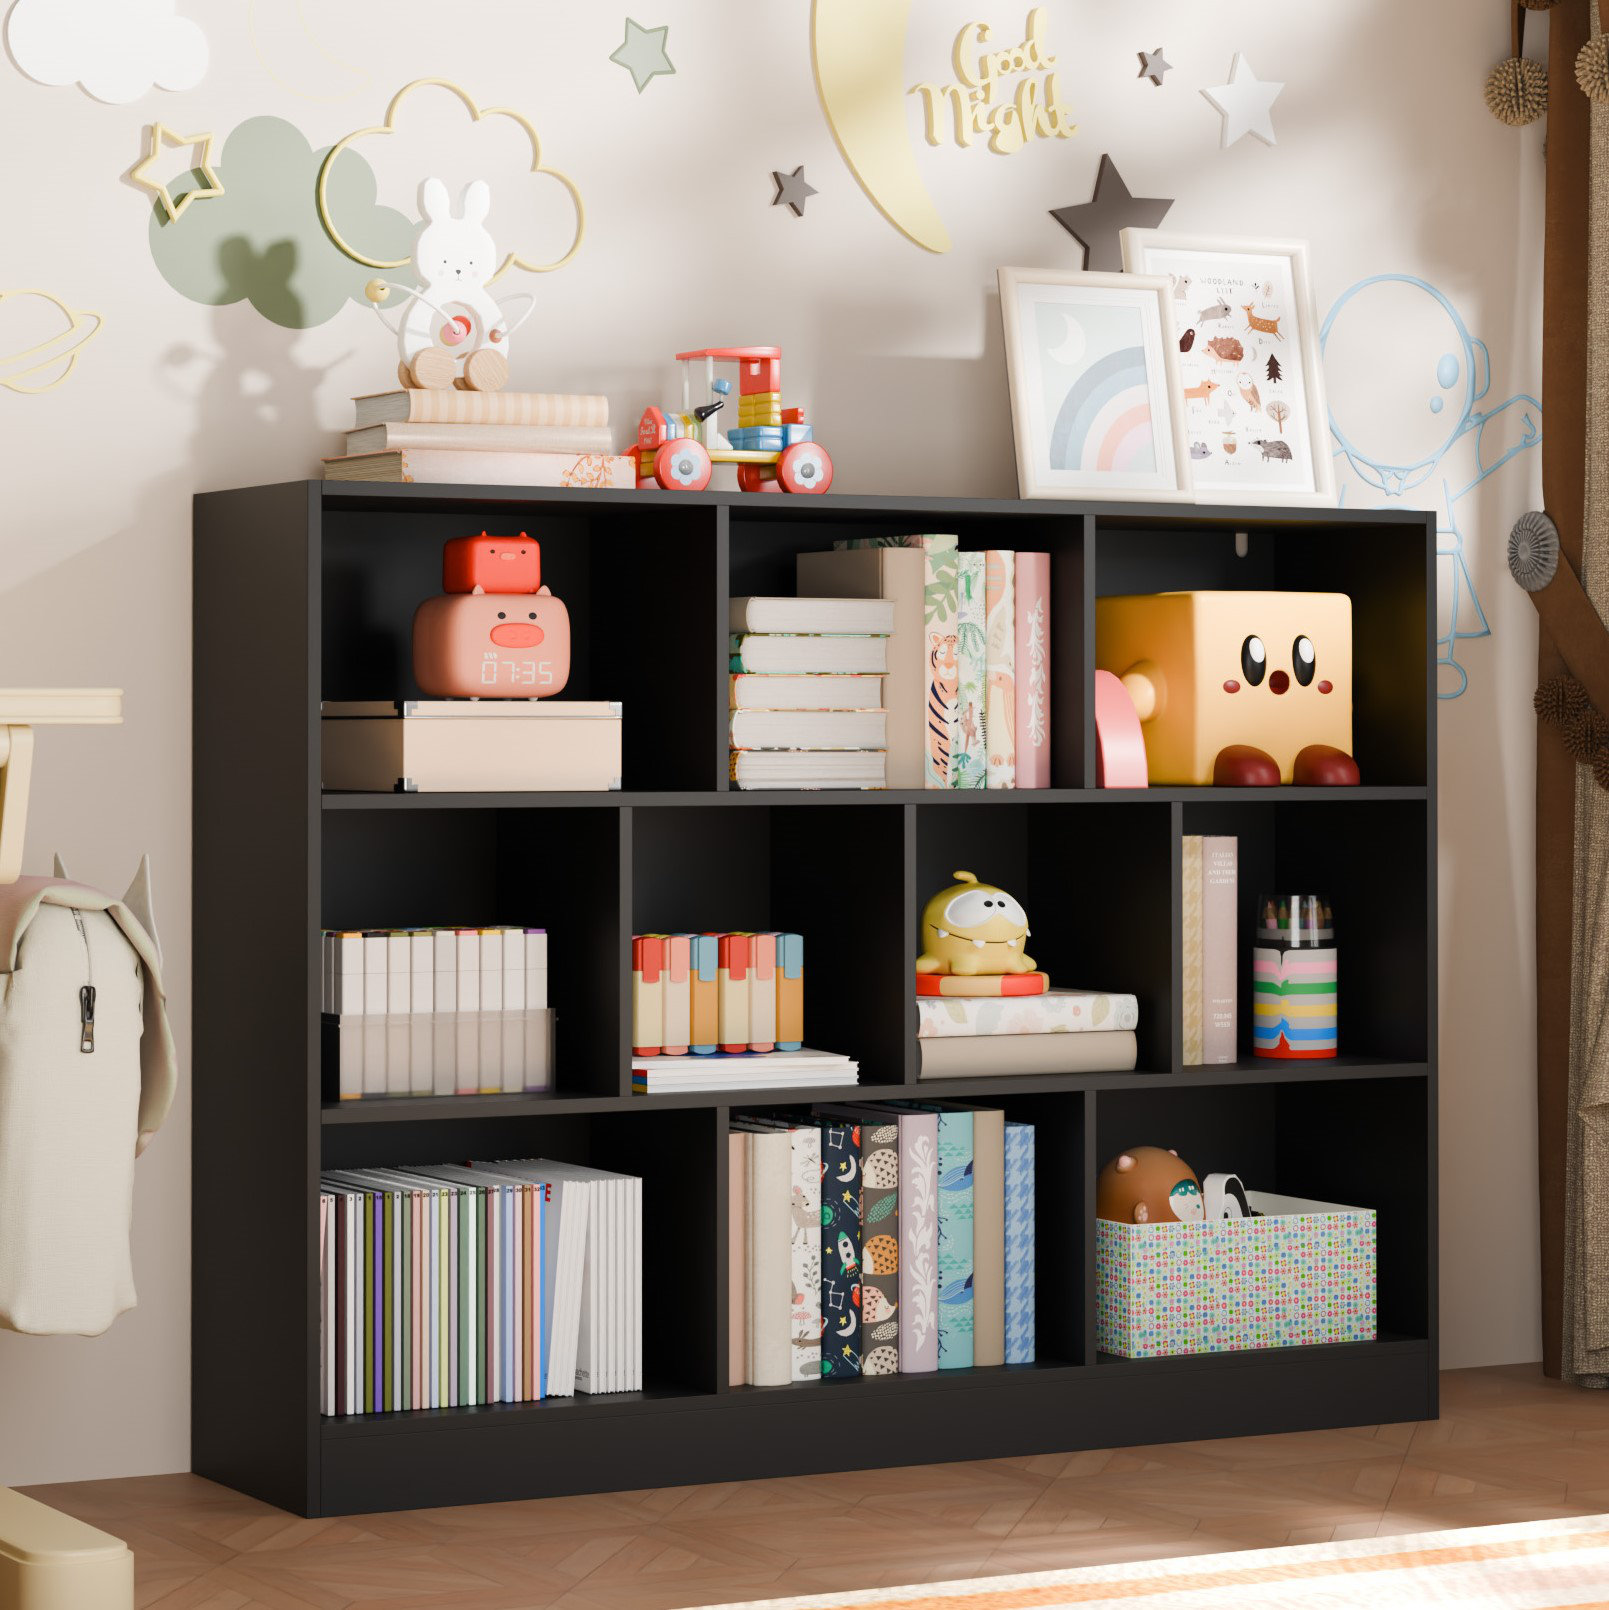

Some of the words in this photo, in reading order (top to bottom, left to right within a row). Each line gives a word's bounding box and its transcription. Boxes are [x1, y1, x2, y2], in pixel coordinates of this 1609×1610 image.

[951, 7, 1056, 105] Good
[906, 71, 1078, 156] Night
[1200, 277, 1245, 288] WOODLAND
[481, 661, 553, 684] 07:35
